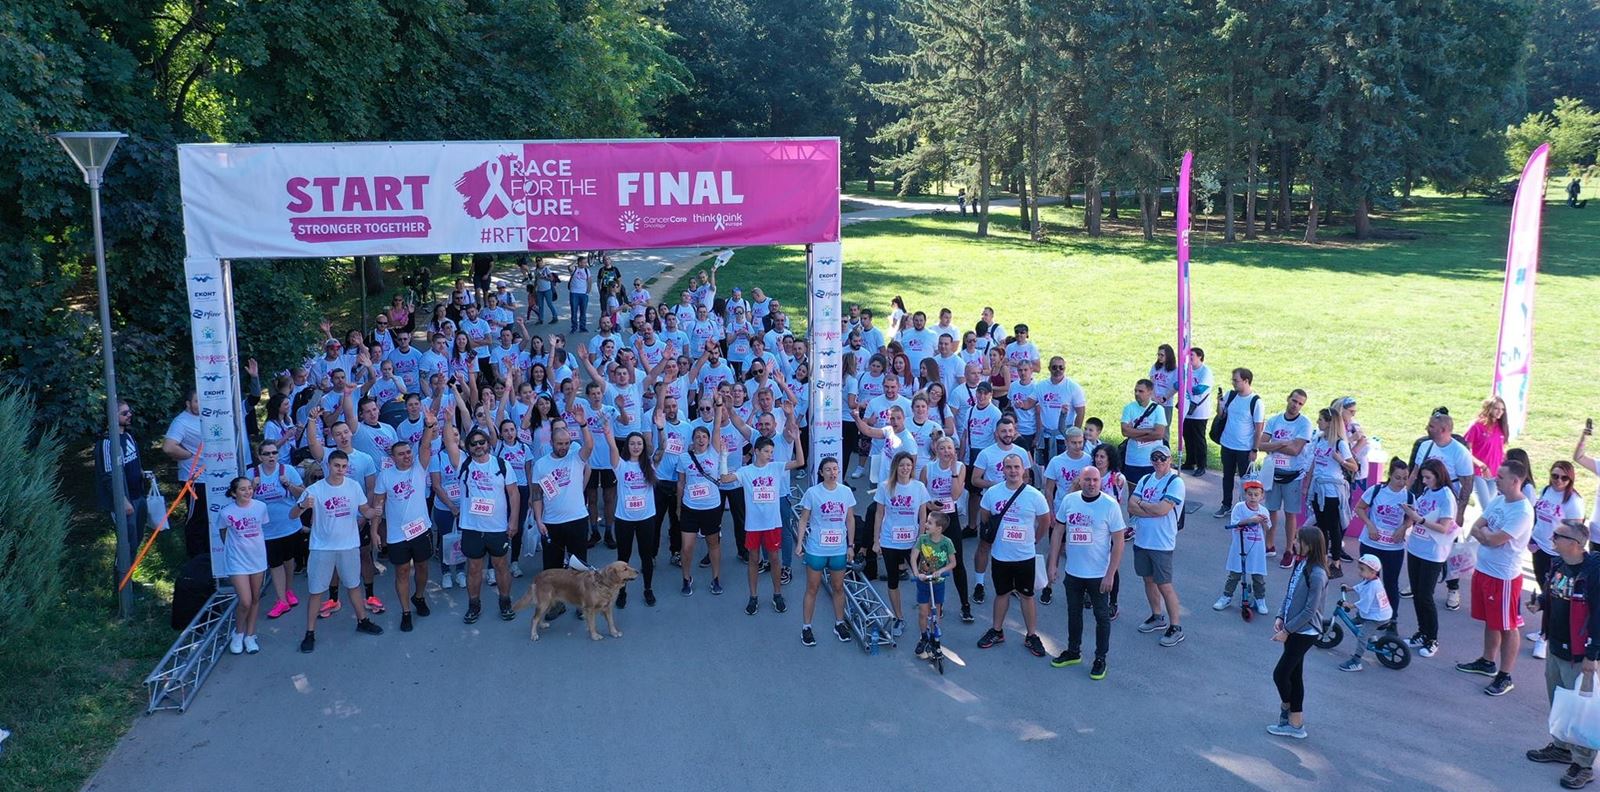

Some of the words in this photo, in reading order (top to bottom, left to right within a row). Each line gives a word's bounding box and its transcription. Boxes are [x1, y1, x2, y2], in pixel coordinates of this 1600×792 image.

[510, 159, 573, 176] RACE
[286, 176, 430, 213] START
[511, 179, 553, 196] FOR
[557, 179, 597, 196] THE
[617, 171, 744, 206] FINAL
[643, 215, 688, 223] CancerCare
[693, 213, 715, 223] think
[723, 212, 743, 224] pink
[297, 224, 362, 235] STRONGER
[364, 222, 425, 233] TOGETHER
[481, 226, 579, 243] #RFTC2021
[409, 525, 423, 535] 1000
[1007, 531, 1023, 539] 2600
